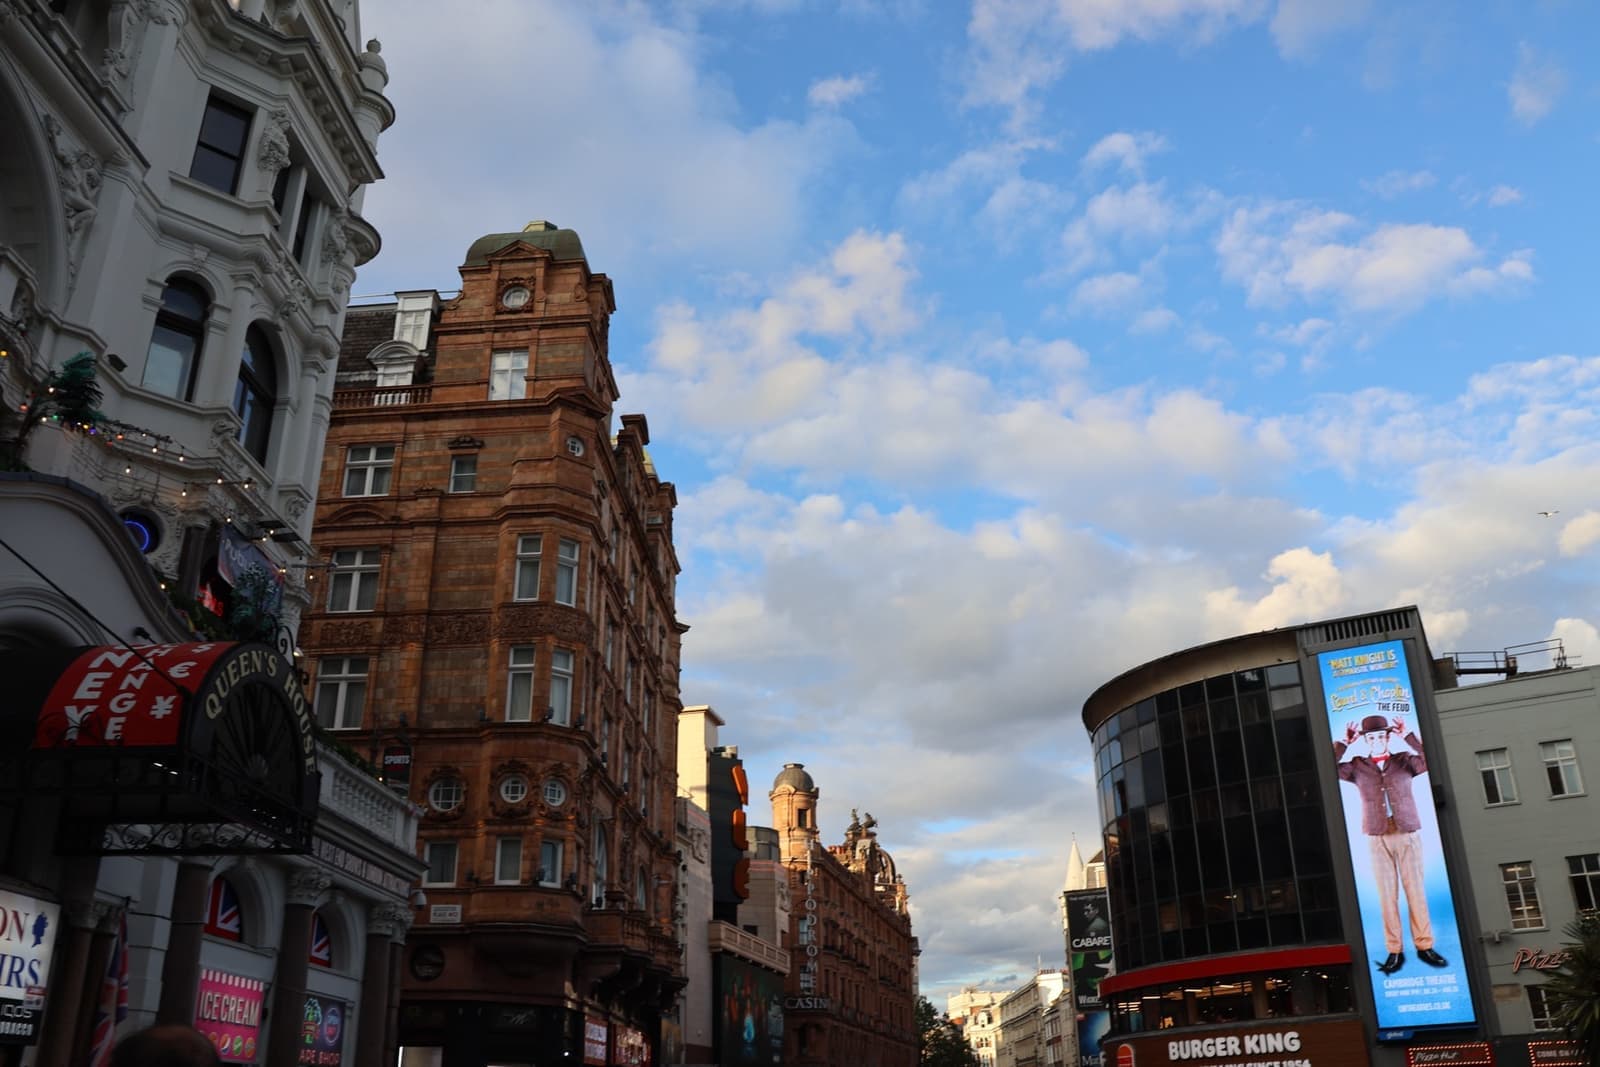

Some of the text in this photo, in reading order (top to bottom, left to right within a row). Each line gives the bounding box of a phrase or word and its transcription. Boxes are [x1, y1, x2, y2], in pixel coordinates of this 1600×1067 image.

[205, 649, 316, 776] QUEEN'S HOUSE
[1377, 702, 1410, 712] THE FEUD
[804, 838, 819, 989] HIPPODROME
[199, 991, 262, 1027] ICE CREAM
[1168, 1031, 1302, 1061] BURGER KING
[1415, 1051, 1457, 1062] Pizza Hut
